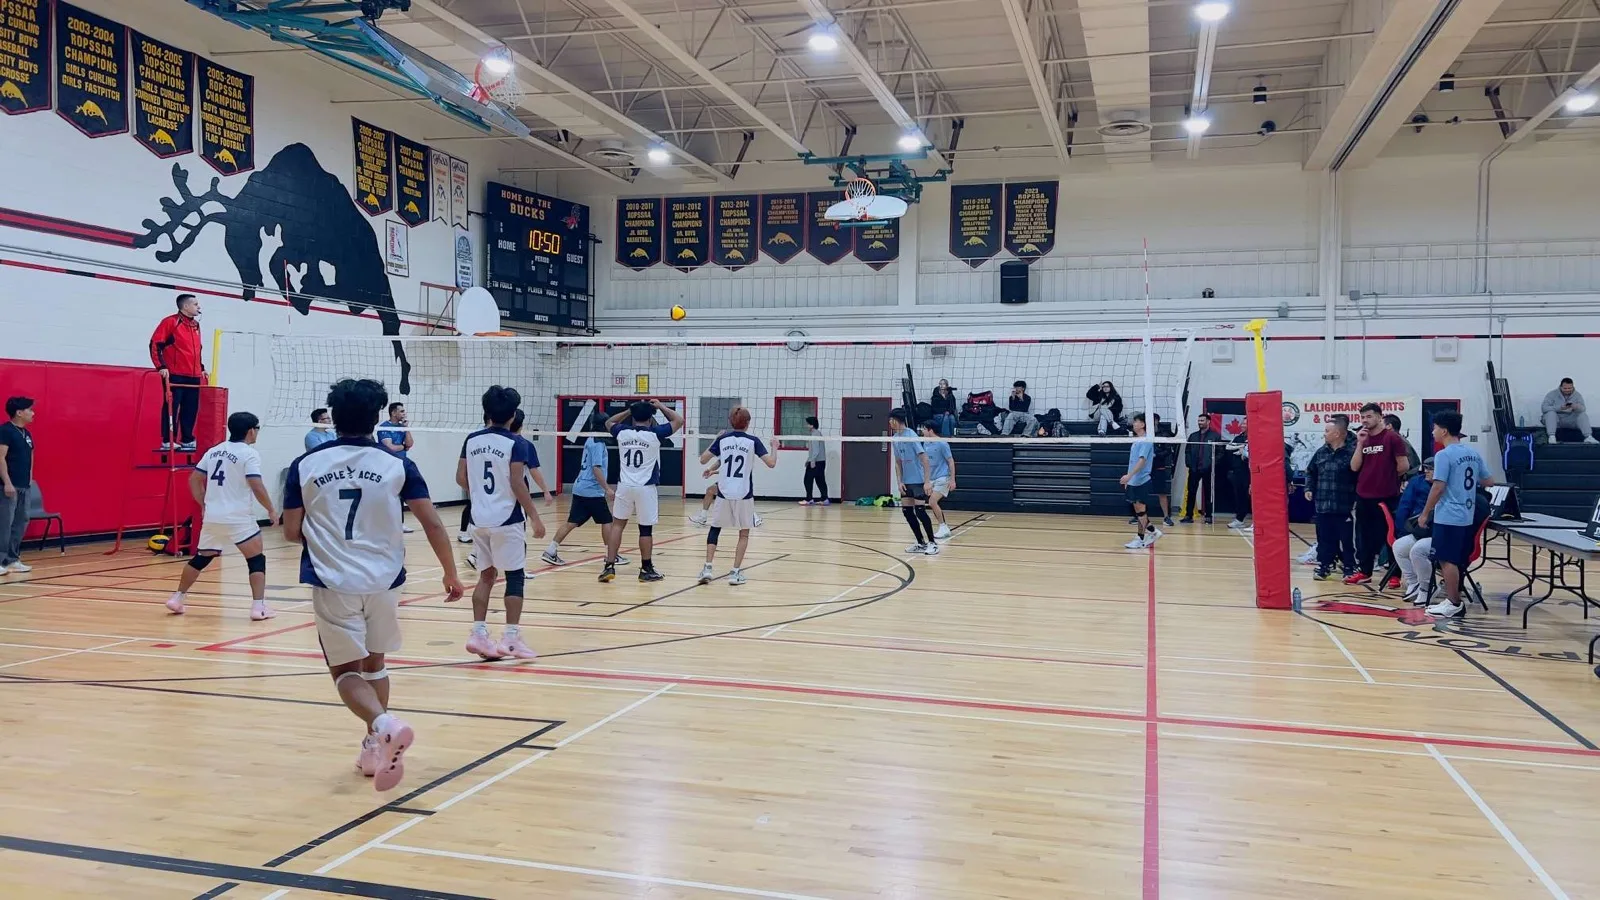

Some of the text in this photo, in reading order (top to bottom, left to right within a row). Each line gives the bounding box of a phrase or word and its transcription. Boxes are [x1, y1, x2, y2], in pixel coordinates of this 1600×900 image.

[8, 16, 40, 35] CURLING
[67, 16, 115, 45] 2003-2004
[19, 33, 38, 48] BOYS
[70, 32, 113, 58] ROPSSAA
[64, 45, 118, 75] CHAMPIONS
[141, 40, 183, 66] 2004-2005
[18, 60, 38, 74] BOYS
[65, 62, 117, 88] GIRLS CURLING
[144, 53, 182, 78] ROPSSAA
[61, 74, 120, 102] GIRLS FASTPITCH
[139, 64, 185, 91] CHAMPIONS
[207, 66, 244, 89] 2005-2006
[205, 88, 246, 112] CHAMPIONS
[209, 79, 242, 100] ROPSSAA
[141, 101, 184, 123] VARSITY BOYS
[147, 113, 178, 131] LACROSSE
[205, 122, 222, 136] GIRLS
[205, 131, 246, 152] FLAG FOOTBALL
[501, 189, 552, 209] HOME OF THE
[720, 200, 750, 208] 2013-2014
[510, 203, 545, 221] BUCKS
[672, 220, 702, 228] CHAMPIONS
[498, 239, 517, 251] HOME
[529, 229, 561, 255] 10:50
[566, 253, 584, 264] GUEST
[1304, 402, 1362, 412] LALIGURANS
[1313, 414, 1321, 424] &
[623, 448, 644, 468] 10
[724, 454, 745, 478] 12
[210, 459, 226, 486] 4
[313, 470, 382, 488] TRIPLE ACES
[483, 460, 496, 495] 5
[1463, 466, 1475, 491] 8
[338, 488, 362, 540] 7
